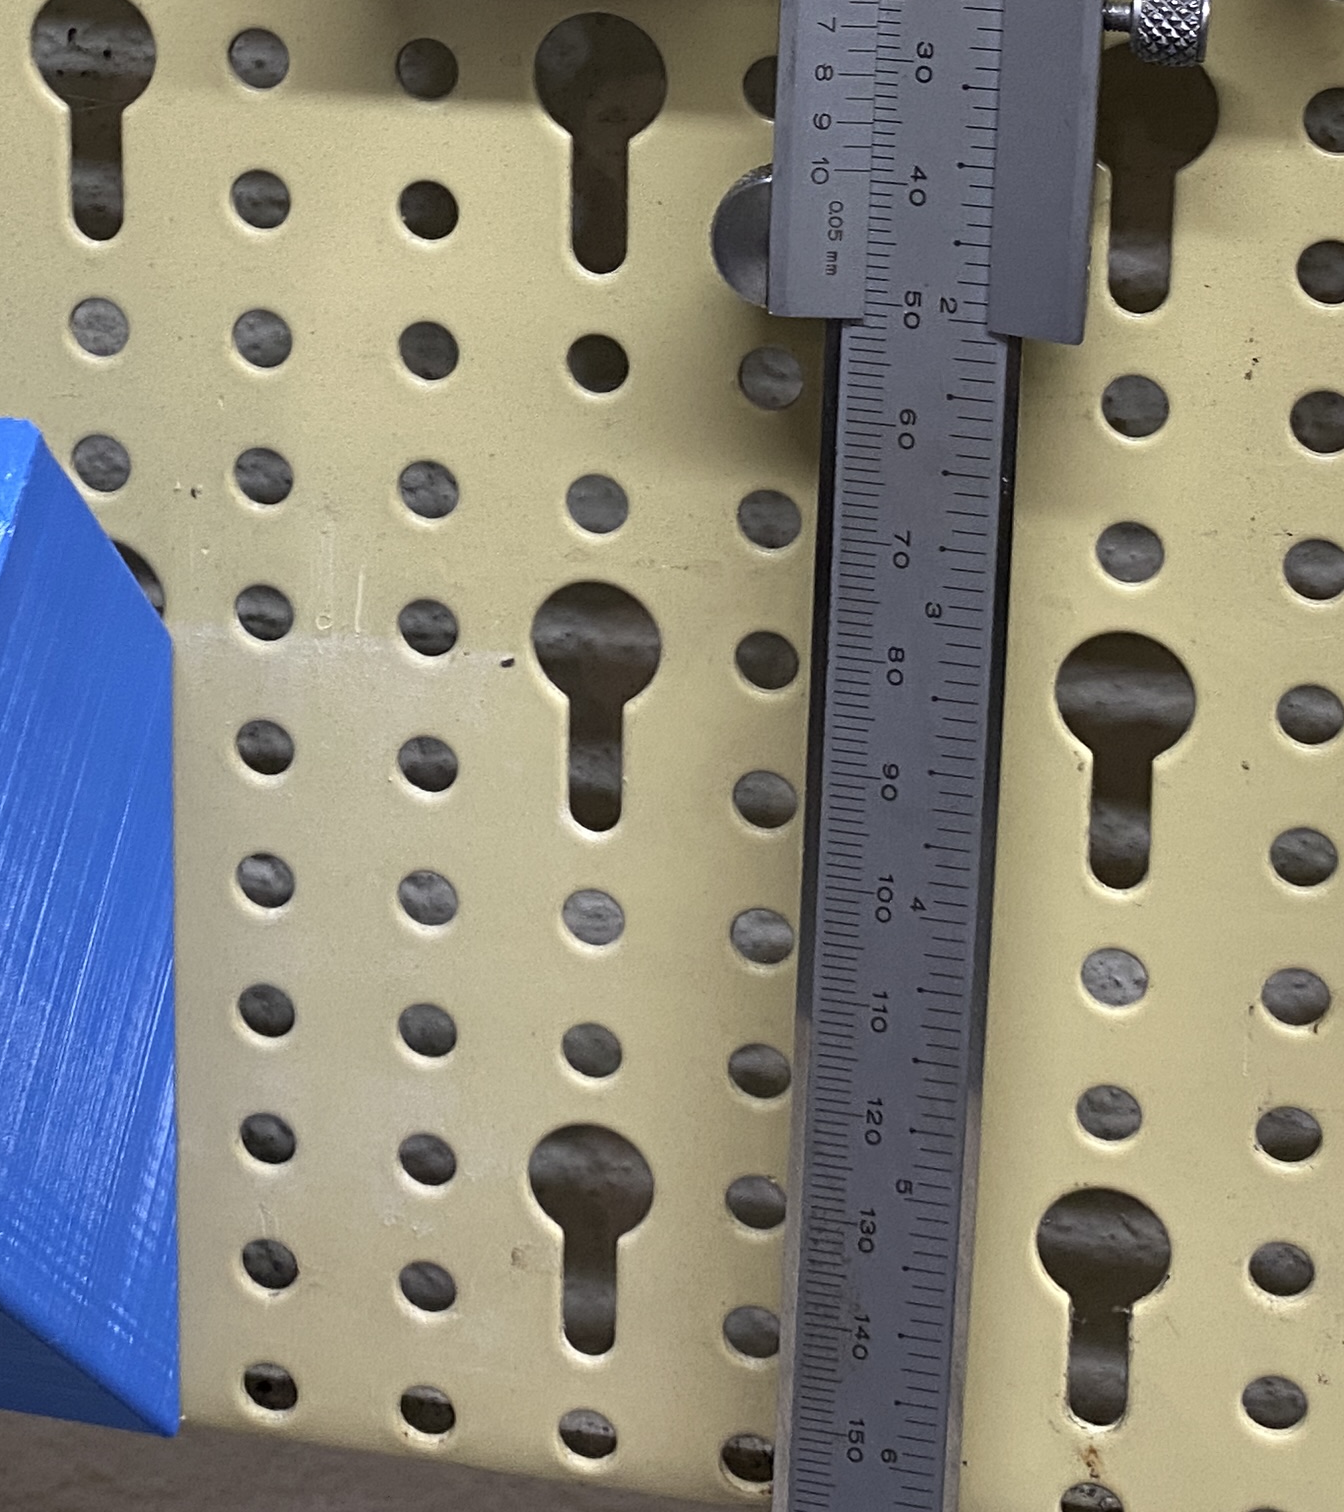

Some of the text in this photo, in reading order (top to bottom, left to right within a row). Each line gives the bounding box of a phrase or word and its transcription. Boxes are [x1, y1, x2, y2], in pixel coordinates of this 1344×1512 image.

[816, 17, 836, 33] 7
[814, 64, 834, 81] 8
[915, 41, 934, 84] 30
[812, 113, 832, 130] 9
[810, 157, 830, 186] 10
[909, 165, 928, 207] 40
[825, 200, 844, 276] 0.05 mm
[903, 290, 922, 330] 50
[939, 298, 957, 314] 2
[897, 408, 916, 450] 60
[892, 530, 911, 570] 70
[924, 601, 943, 619] 3
[886, 647, 905, 686] 80
[880, 763, 900, 802] 90
[874, 874, 895, 924] 100
[909, 896, 928, 913] 4
[870, 991, 889, 1034] 110
[864, 1097, 884, 1146] 120
[895, 1178, 914, 1195] 5
[857, 1208, 877, 1255] 130
[852, 1314, 871, 1361] 140
[846, 1418, 866, 1464] 150
[880, 1448, 898, 1465] 6
